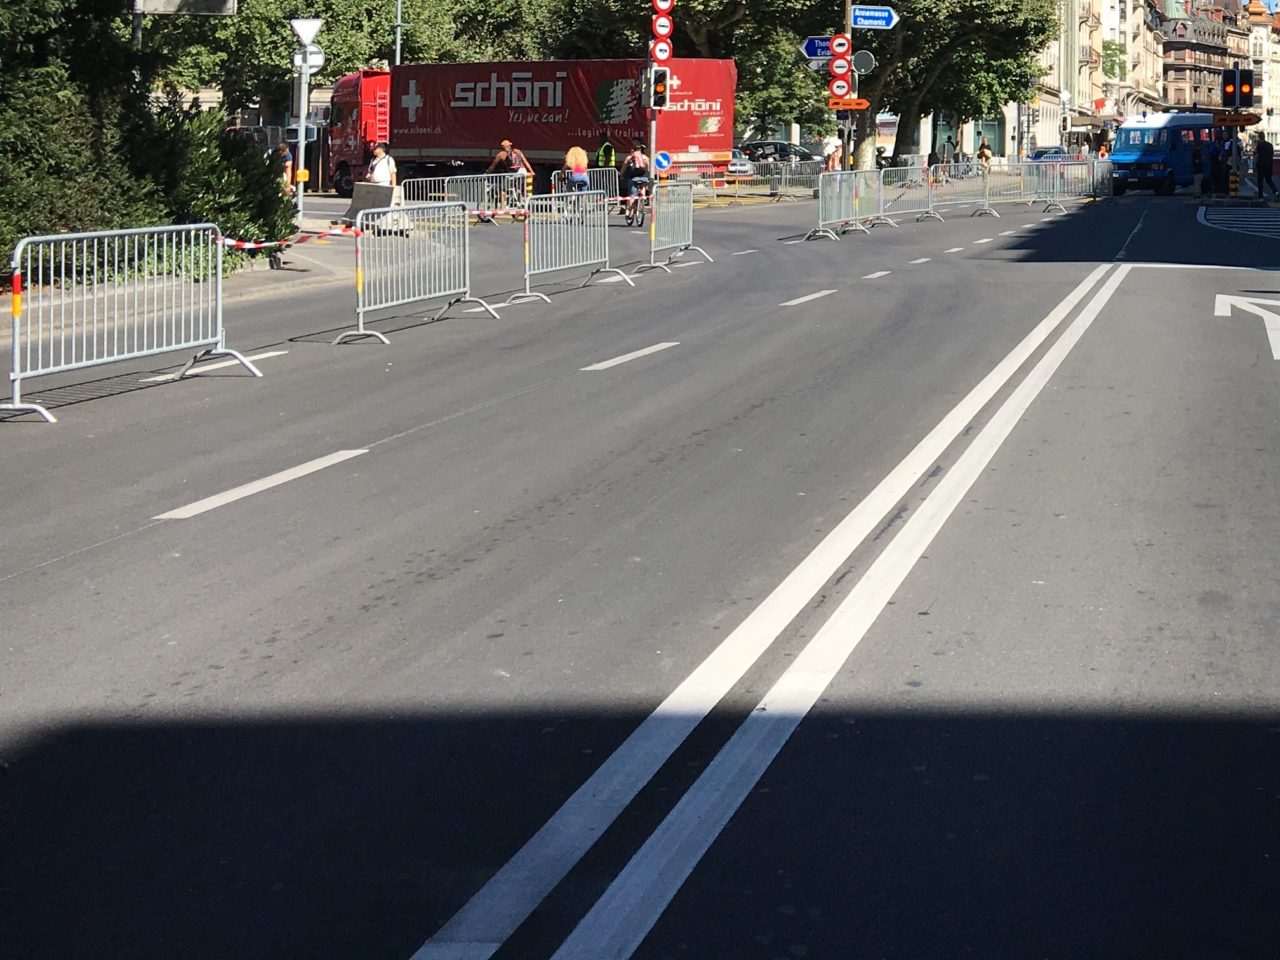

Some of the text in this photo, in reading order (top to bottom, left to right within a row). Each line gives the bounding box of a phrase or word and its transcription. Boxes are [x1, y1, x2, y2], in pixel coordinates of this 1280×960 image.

[854, 9, 889, 18] Annemasse
[857, 18, 886, 26] Chamonix
[450, 72, 567, 107] schöni
